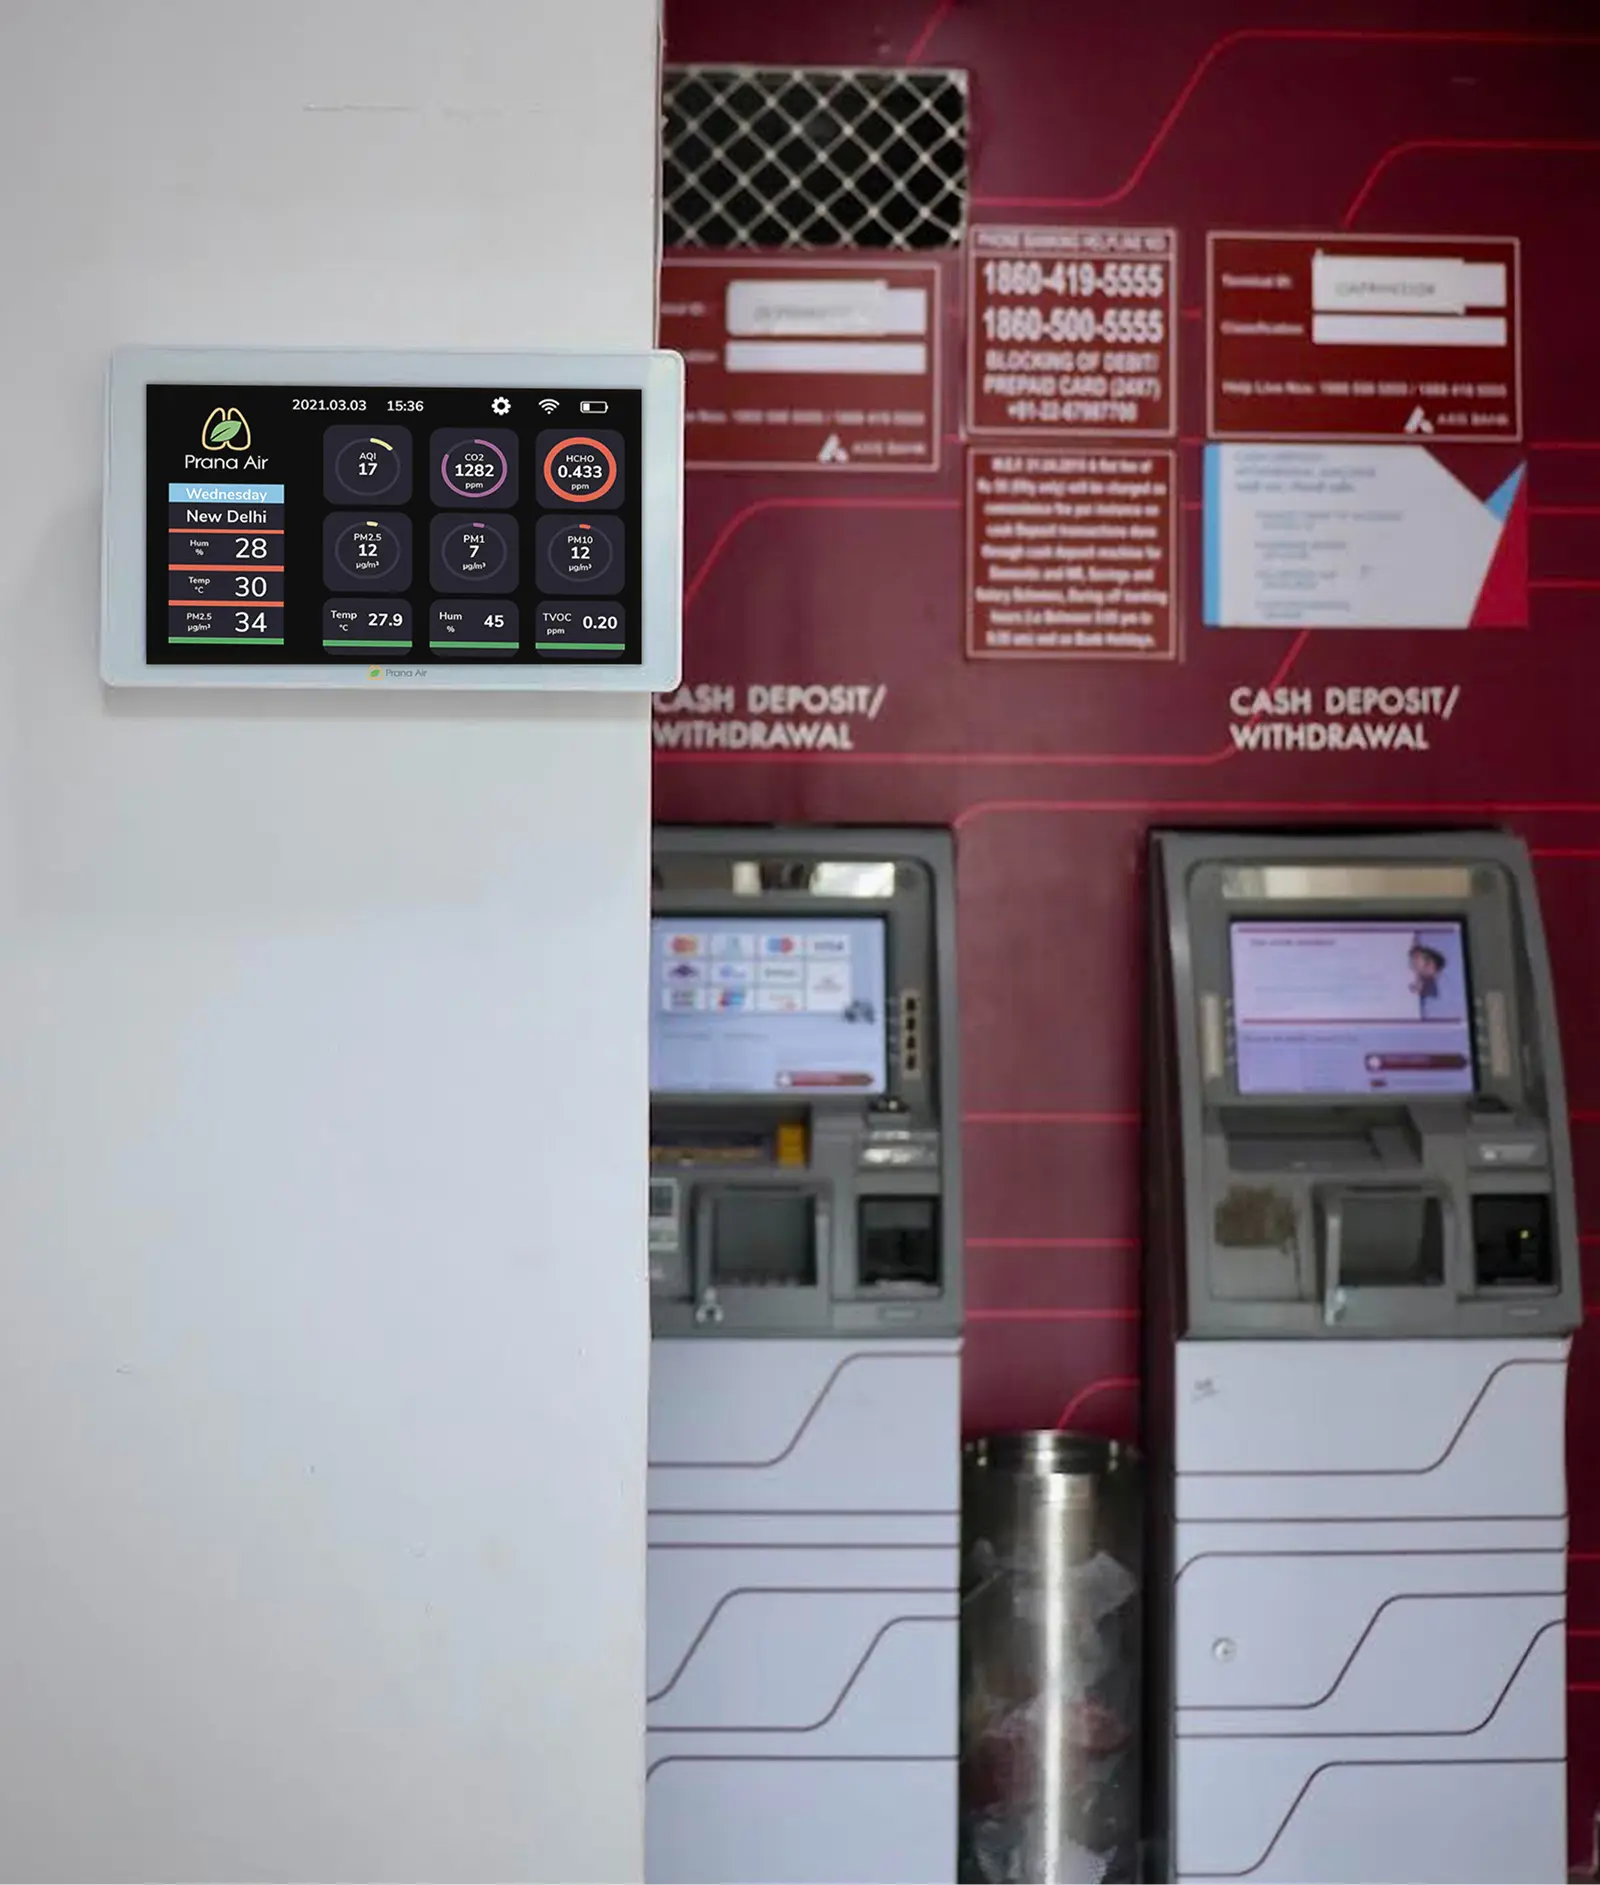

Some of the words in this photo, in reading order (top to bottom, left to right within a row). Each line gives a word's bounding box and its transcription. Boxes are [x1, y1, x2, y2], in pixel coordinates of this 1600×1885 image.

[983, 260, 1164, 298] 1860-419-5555
[983, 306, 1164, 344] 1860-500-5555
[1058, 374, 1108, 397] CARD
[292, 399, 367, 412] 2021.03.03
[386, 400, 424, 412] 15:36
[184, 454, 239, 471] Prana
[243, 454, 269, 471] Air
[359, 451, 377, 463] AQI
[464, 453, 484, 462] CO2
[565, 454, 595, 464] HCHO
[358, 463, 378, 476] 17
[454, 464, 495, 478] 1282
[557, 465, 603, 479] 0.433
[465, 481, 484, 491] ppm
[571, 482, 590, 492] ppm
[185, 487, 268, 503] Wednesday
[186, 509, 222, 524] New
[226, 509, 267, 524] Delhi
[189, 538, 209, 548] Hum
[353, 532, 382, 543] PM2.5
[463, 534, 486, 544] PM1
[567, 535, 594, 545] PM10
[195, 548, 204, 557] %
[234, 537, 268, 559] 28
[357, 544, 378, 557] 12
[469, 545, 480, 558] 7
[570, 546, 591, 559] 12
[188, 576, 210, 588] Temp
[234, 576, 268, 598] 30
[186, 612, 213, 621] PM2.5
[234, 611, 268, 633] 34
[330, 610, 358, 621] Temp
[368, 612, 404, 627] 27.9
[439, 611, 463, 621] Hum
[483, 614, 505, 628] 45
[542, 612, 572, 622] TVOC
[582, 615, 619, 630] 0.20
[446, 625, 456, 634] %
[546, 627, 565, 637] ppm
[385, 668, 413, 678] Prana
[414, 668, 428, 678] Air
[652, 684, 735, 714] CASH
[746, 684, 888, 721] DEPOSIT/
[1229, 686, 1313, 716] CASH
[1324, 685, 1461, 721] DEPOSIT/
[652, 720, 854, 750] WITHDRAWAL
[1229, 721, 1430, 750] WITHDRAWAL
